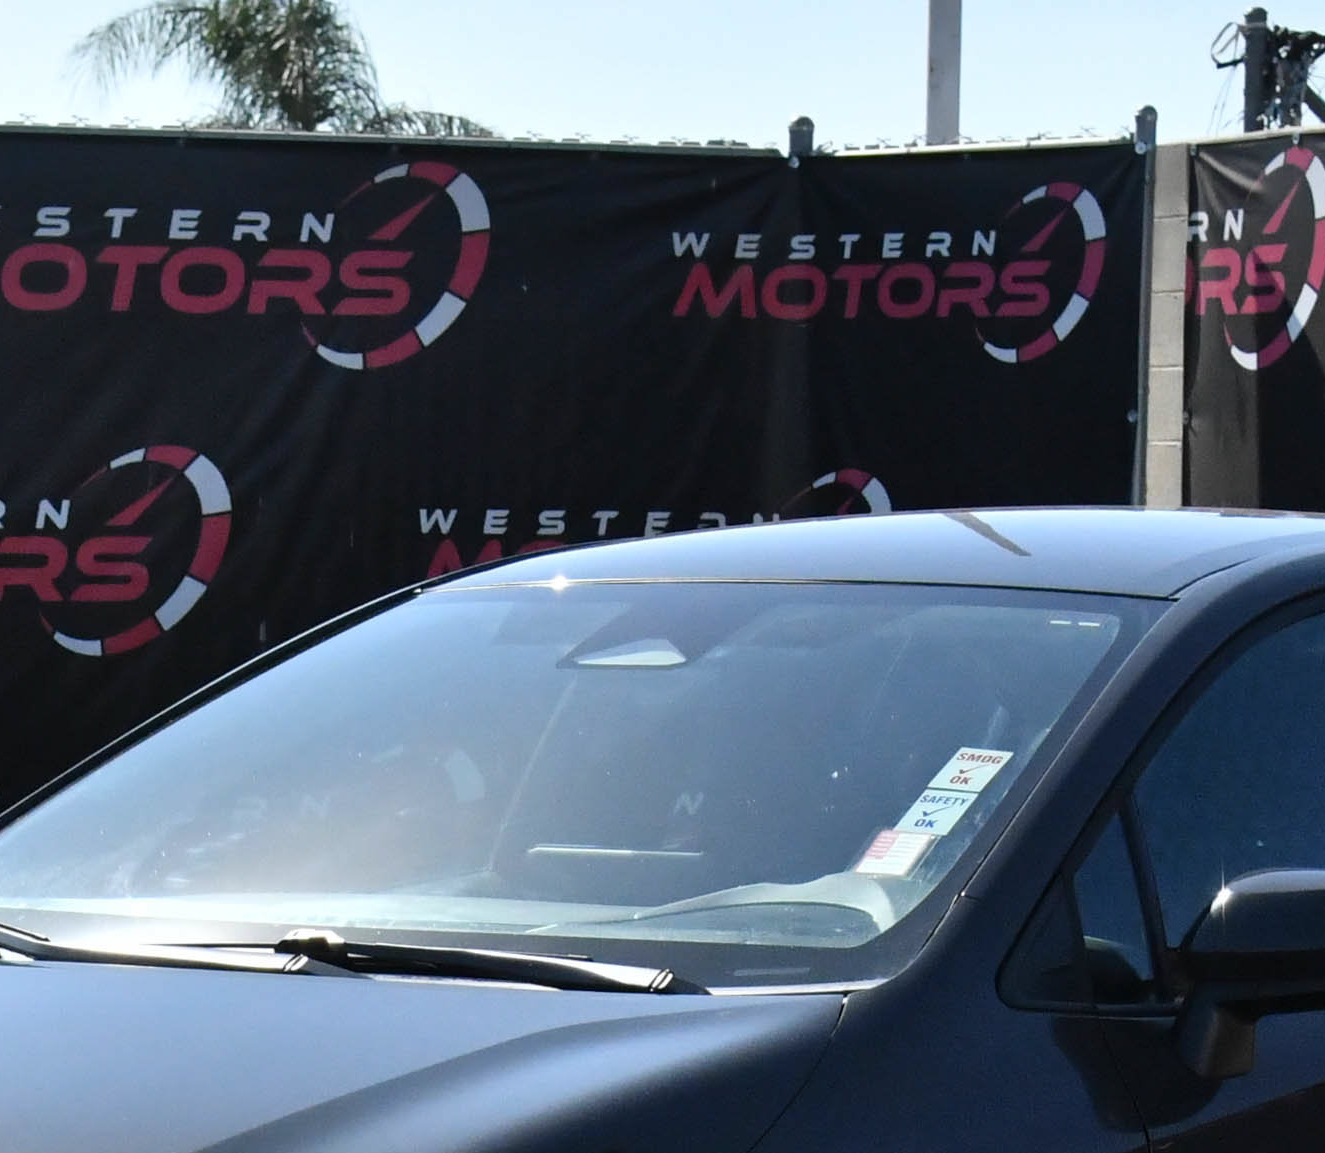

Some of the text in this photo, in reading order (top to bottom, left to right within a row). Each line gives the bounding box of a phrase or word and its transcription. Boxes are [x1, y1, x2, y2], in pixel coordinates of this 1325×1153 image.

[672, 230, 996, 260] WESTERN
[673, 260, 1050, 319] MOTORS
[956, 752, 1004, 765] SMOG
[949, 775, 972, 786] OK
[920, 794, 969, 807] SAFETY
[914, 818, 938, 829] OK
